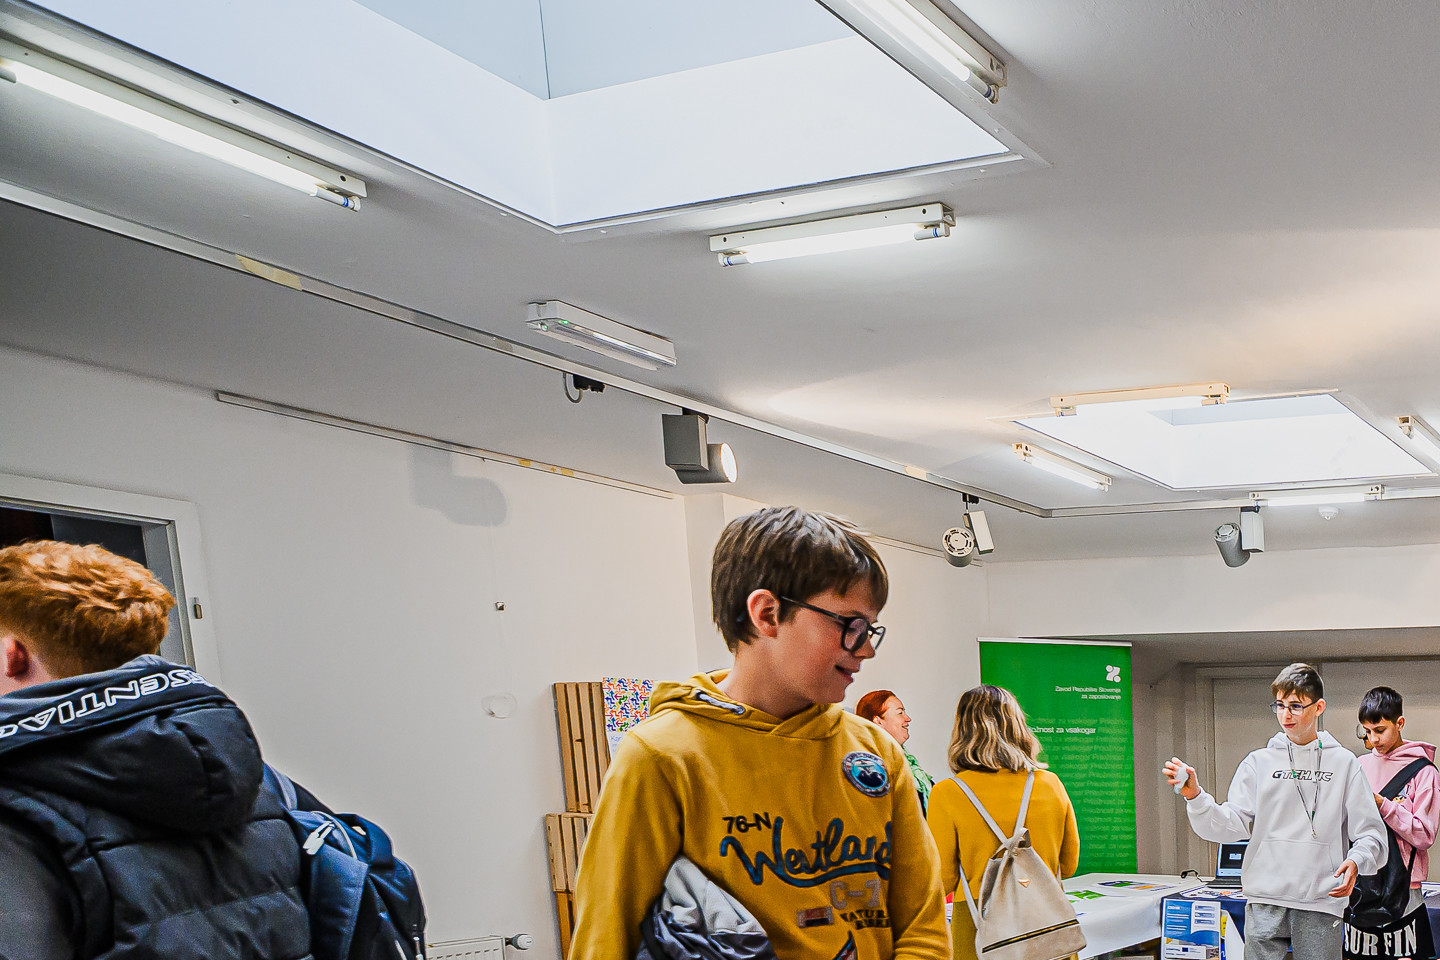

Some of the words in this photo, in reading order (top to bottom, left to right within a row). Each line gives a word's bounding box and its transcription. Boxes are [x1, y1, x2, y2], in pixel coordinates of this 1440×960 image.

[1065, 727, 1096, 735] vsakogar
[723, 811, 772, 833] 76-N
[830, 878, 881, 911] C-7
